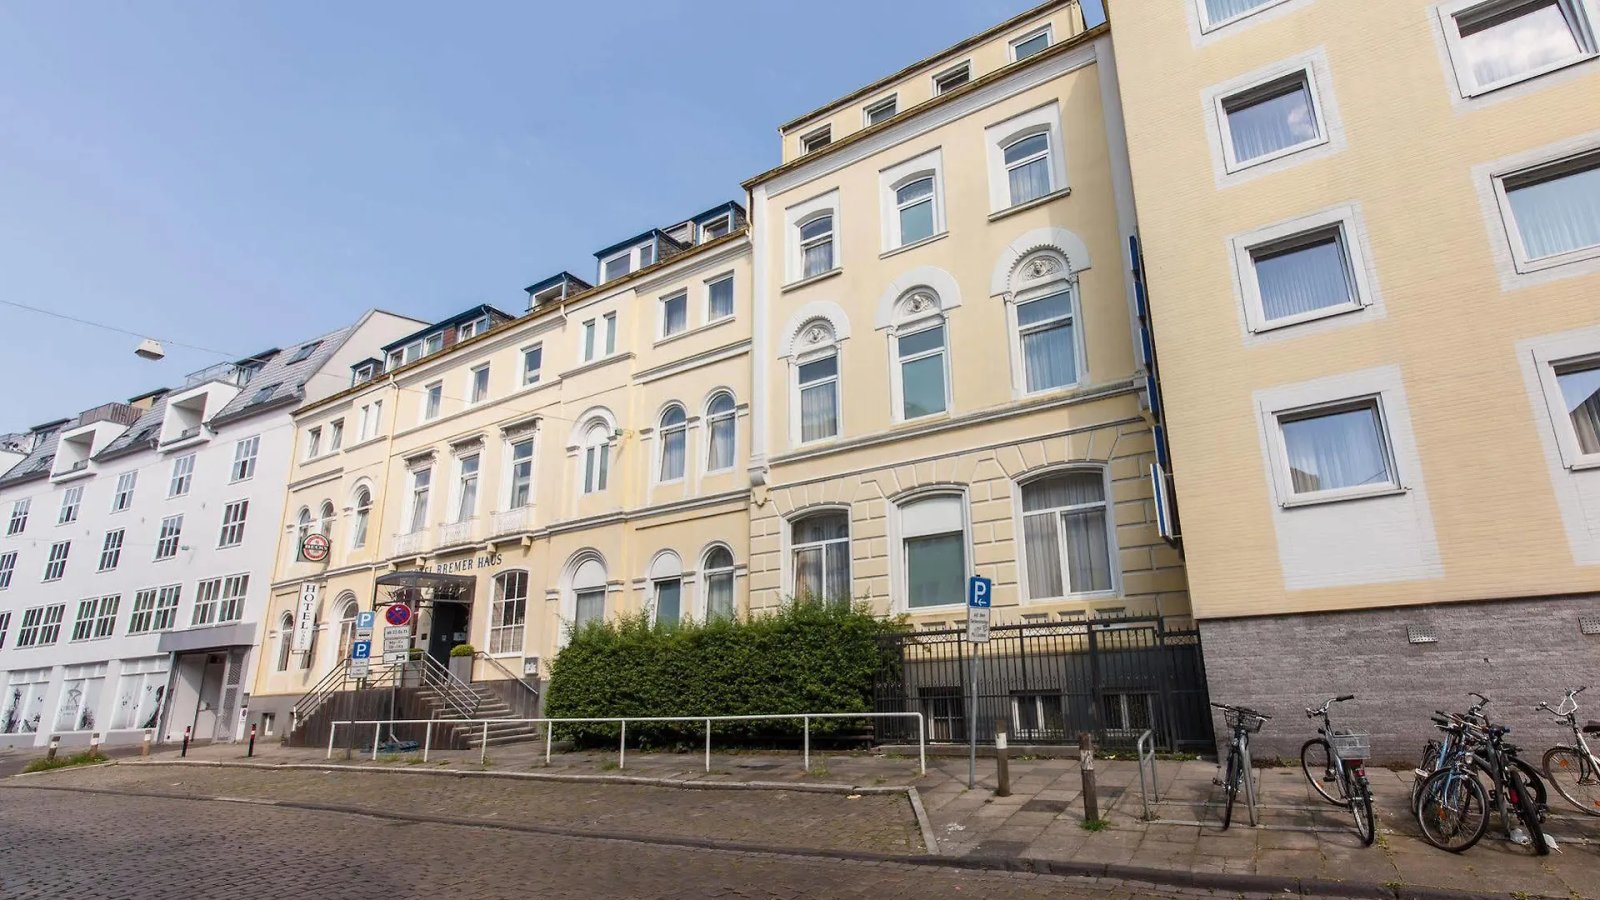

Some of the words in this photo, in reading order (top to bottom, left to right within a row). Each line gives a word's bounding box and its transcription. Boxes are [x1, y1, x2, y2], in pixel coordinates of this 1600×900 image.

[437, 559, 474, 574] BREMER
[478, 553, 503, 569] HAUS
[974, 581, 987, 603] P
[301, 584, 316, 630] HOTEL
[360, 613, 371, 627] P
[356, 643, 367, 657] P
